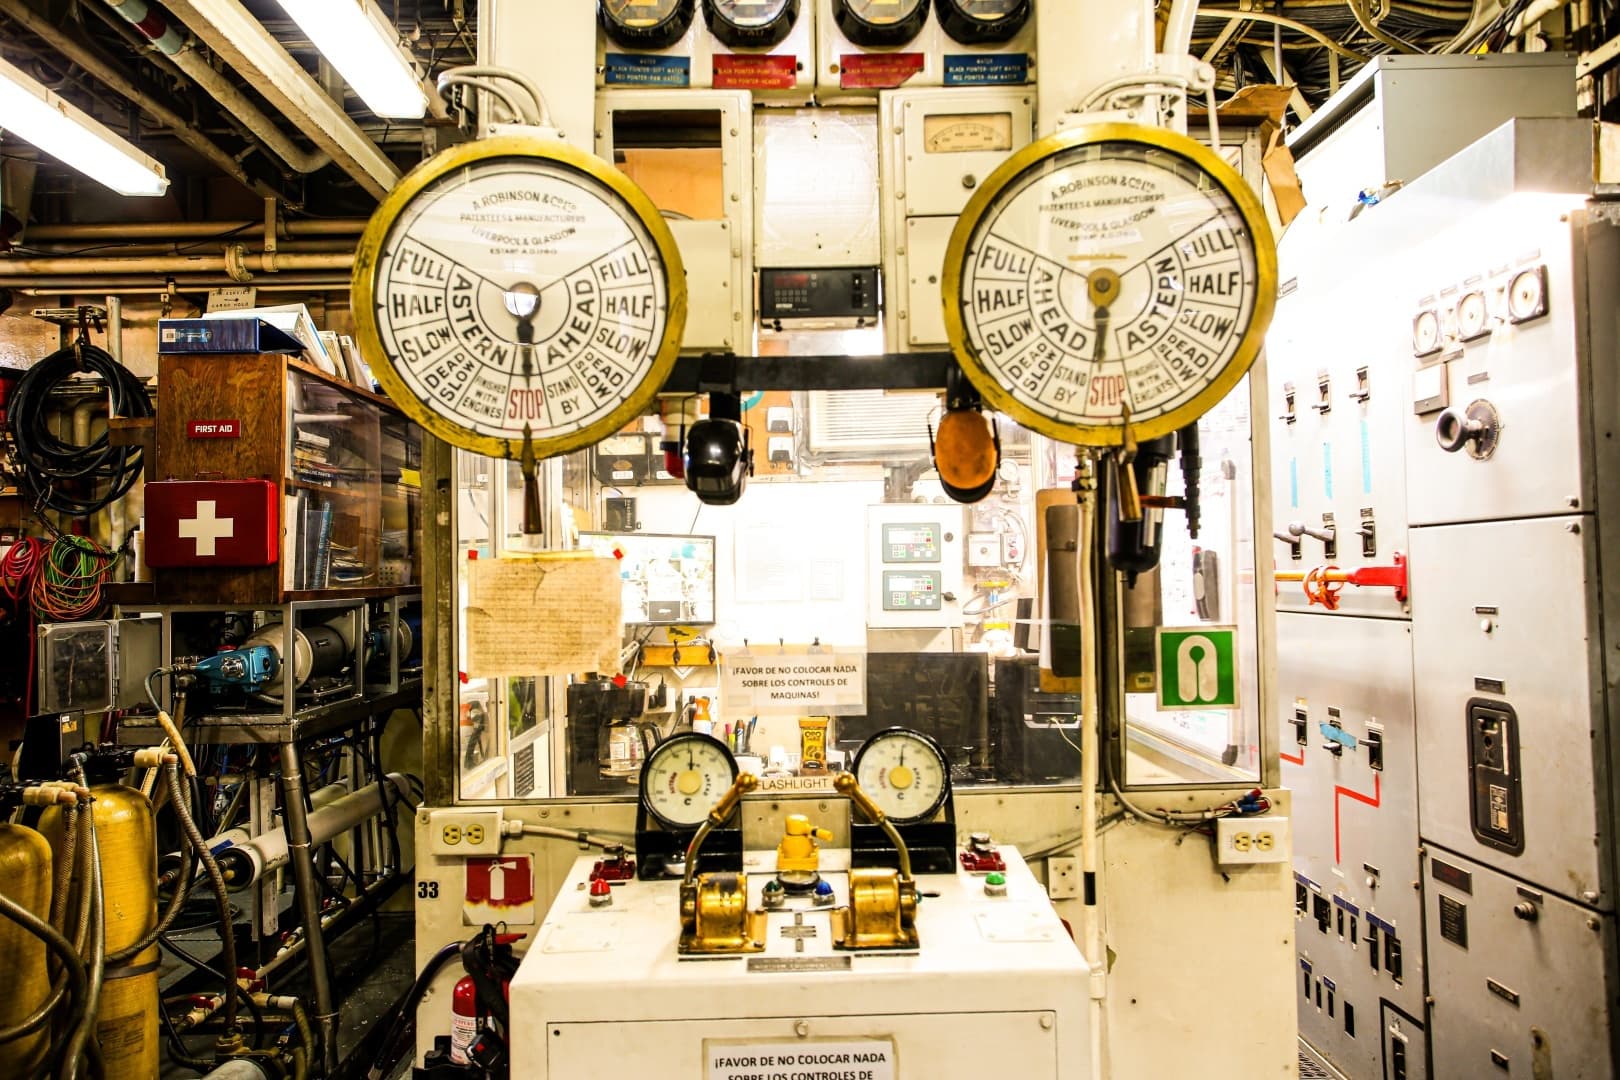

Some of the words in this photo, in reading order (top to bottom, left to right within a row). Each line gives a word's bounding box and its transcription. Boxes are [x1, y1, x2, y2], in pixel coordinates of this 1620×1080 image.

[481, 190, 541, 207] ROBINSON
[542, 193, 549, 204] &
[1060, 175, 1118, 196] ROBINSON
[1119, 175, 1127, 187] &
[1093, 193, 1166, 208] MANUFACTURERS
[515, 213, 586, 223] MANUFACTURERS
[1050, 215, 1100, 232] LIVERPOOL
[1101, 221, 1108, 231] &
[1109, 206, 1156, 231] GLASGOW
[471, 224, 521, 246] LIVERPOOL
[522, 237, 529, 246] &
[531, 227, 577, 246] GLASGOW
[1183, 228, 1234, 262] FULL
[396, 248, 445, 282] FULL
[600, 252, 648, 283] FULL
[980, 245, 1027, 275] FULL
[1190, 271, 1240, 296] HALF
[392, 292, 444, 319] HALF
[606, 295, 653, 320] HALF
[977, 289, 1025, 314] HALF
[1034, 266, 1088, 352] AHEAD
[452, 273, 508, 366] ASTERN
[547, 278, 596, 366] AHEAD
[1180, 308, 1234, 341] SLOW
[402, 325, 452, 364] SLOW
[596, 327, 646, 362] SLOW
[986, 318, 1035, 356] SLOW
[1008, 342, 1048, 380] DEAD
[1158, 343, 1198, 383] SLOW
[1168, 333, 1210, 369] DEAD
[424, 352, 465, 390] DEAD
[439, 359, 476, 401] SLOW
[574, 360, 613, 398] SLOW
[585, 351, 624, 387] DEAD
[1023, 349, 1058, 392] SLOW
[1054, 365, 1087, 387] STAND
[1136, 372, 1161, 389] WITH
[474, 389, 499, 404] WITH
[475, 375, 507, 394] FINISHED
[547, 376, 580, 399] STAND
[1054, 387, 1079, 405] BY
[1090, 374, 1126, 407] STOP
[1134, 379, 1174, 405] ENGINES
[462, 396, 504, 419] ENGINES
[508, 388, 544, 420] STOP
[561, 396, 581, 415] BY
[195, 425, 217, 433] FIRST
[218, 424, 233, 433] AID
[732, 667, 764, 676] ¡FAVOR
[765, 667, 777, 675] DE
[778, 666, 791, 675] NO
[792, 665, 831, 674] COLOCAR
[833, 665, 858, 673] NADA
[742, 680, 769, 688] SOBRE
[770, 679, 786, 687] LOS
[787, 678, 836, 687] CONTROLES
[836, 678, 848, 686] DE
[770, 690, 820, 699] MAQUINAS!
[417, 881, 439, 899] 33
[714, 1057, 757, 1069] ¡FAVOR
[760, 1056, 775, 1066] DE
[777, 1055, 795, 1066] NO
[798, 1053, 850, 1064] COLOCAR
[853, 1052, 886, 1063] NADA
[790, 1071, 856, 1080] CONTROLES
[858, 1070, 873, 1080] DE
